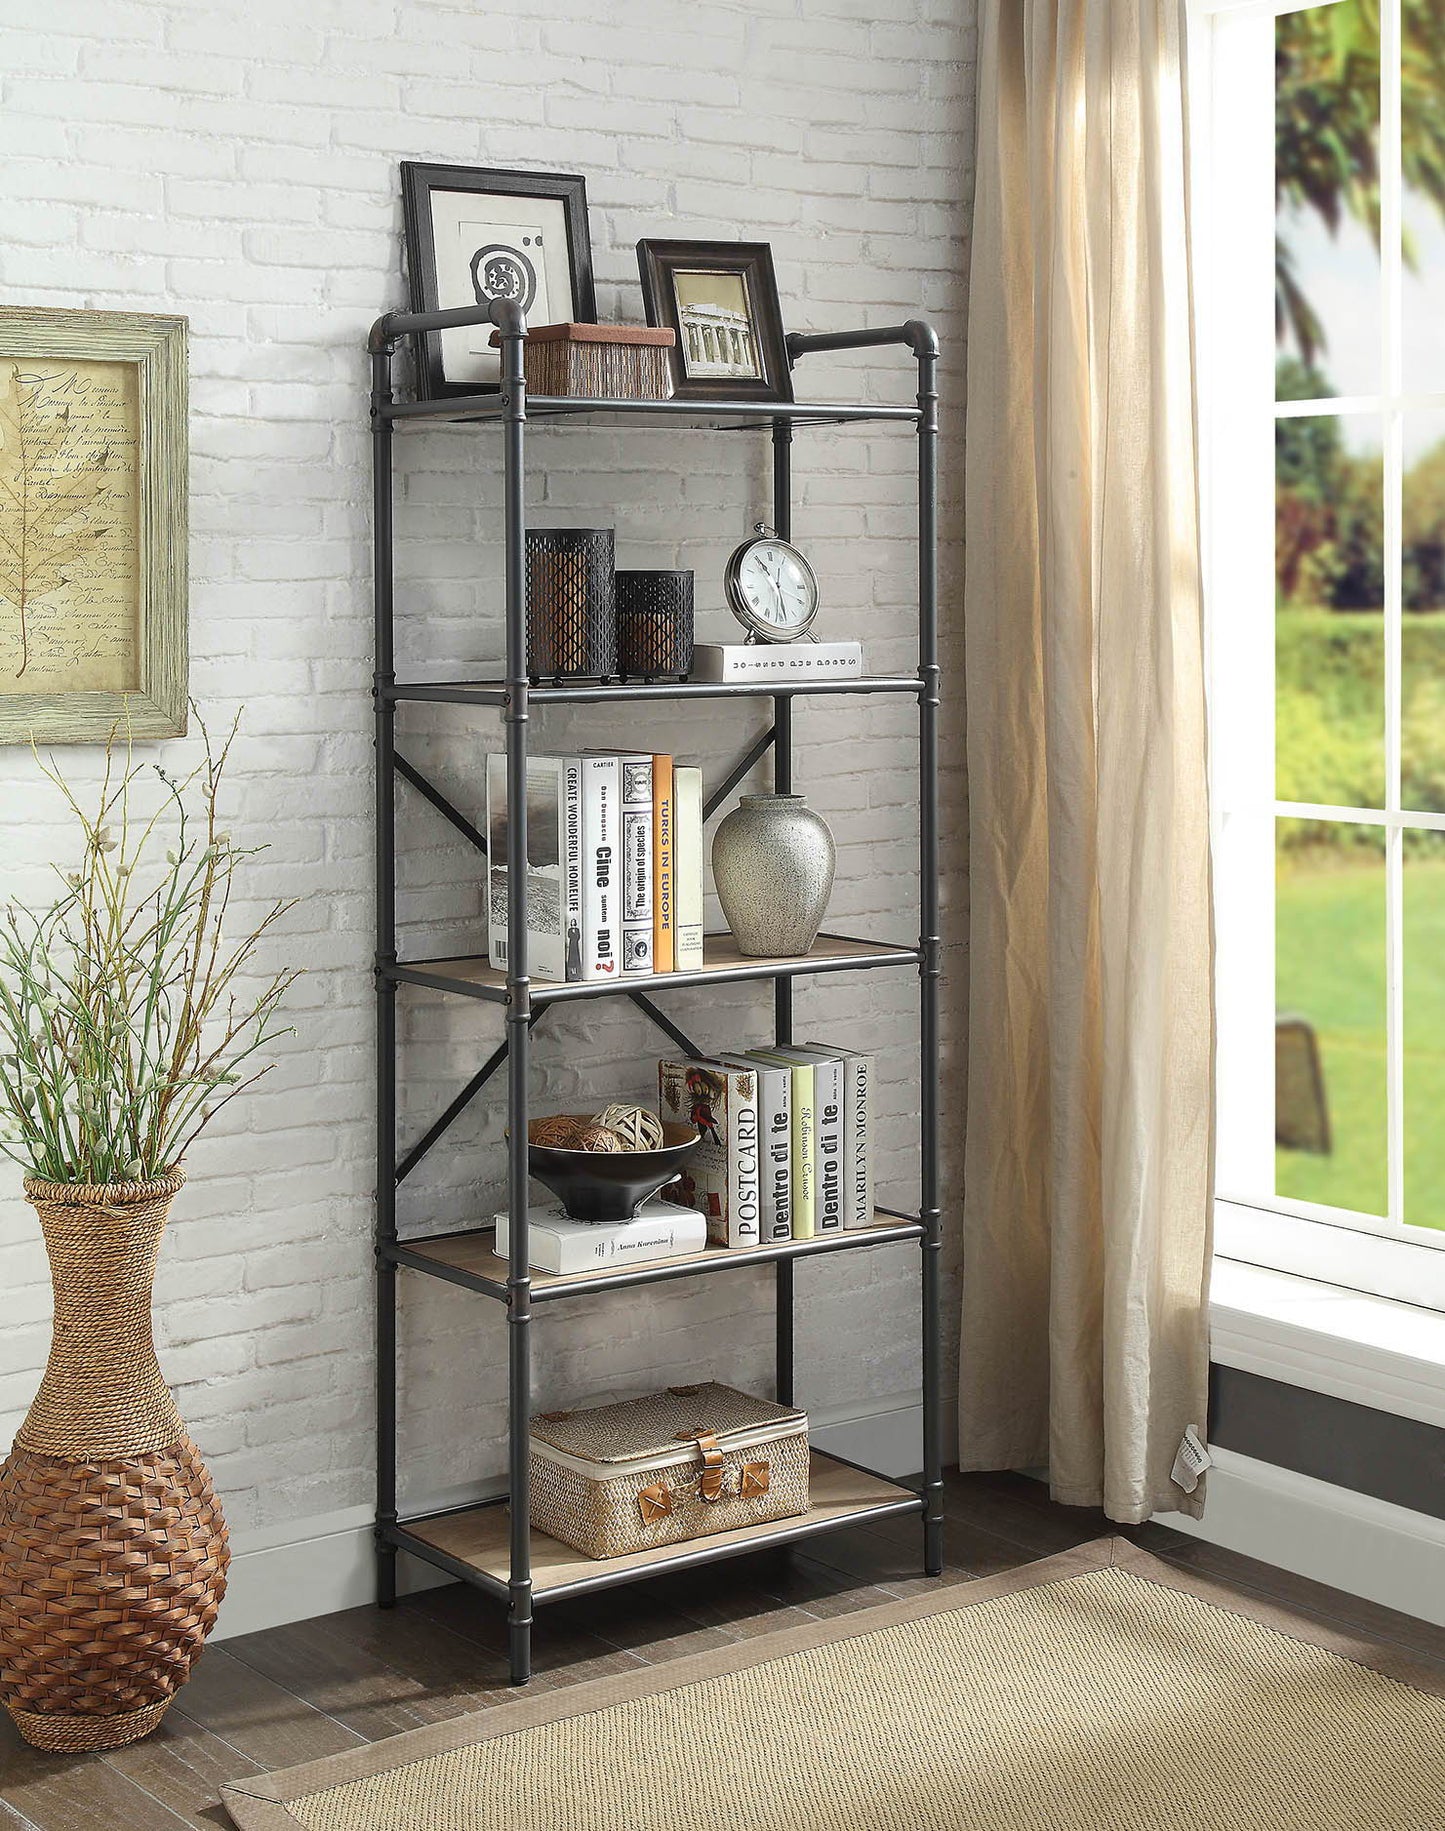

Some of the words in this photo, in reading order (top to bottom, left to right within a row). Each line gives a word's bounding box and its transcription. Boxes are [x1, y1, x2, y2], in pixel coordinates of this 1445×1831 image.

[733, 661, 785, 669] passion
[790, 660, 812, 668] and
[816, 658, 857, 667] Speed
[567, 767, 577, 801] CREATE
[567, 803, 578, 862] WONDERFUL
[661, 800, 669, 846] TURKS
[635, 826, 646, 858] species
[661, 851, 669, 867] IN
[596, 846, 612, 888] Cine
[635, 858, 646, 867] of
[568, 865, 579, 912] HOMELIFE
[635, 868, 646, 892] origin
[635, 892, 646, 908] The
[661, 873, 670, 930] EUROPE
[821, 1104, 839, 1125] te
[856, 1063, 867, 1139] MONROE
[771, 1112, 789, 1133] te
[801, 1107, 812, 1160] Robinson
[770, 1142, 789, 1163] di
[820, 1134, 838, 1154] di
[737, 1108, 757, 1237] POSTCARD
[801, 1163, 812, 1200] Crusoe
[856, 1142, 867, 1222] MARILYN
[772, 1168, 790, 1239] Dentro
[821, 1160, 839, 1229] Dentro
